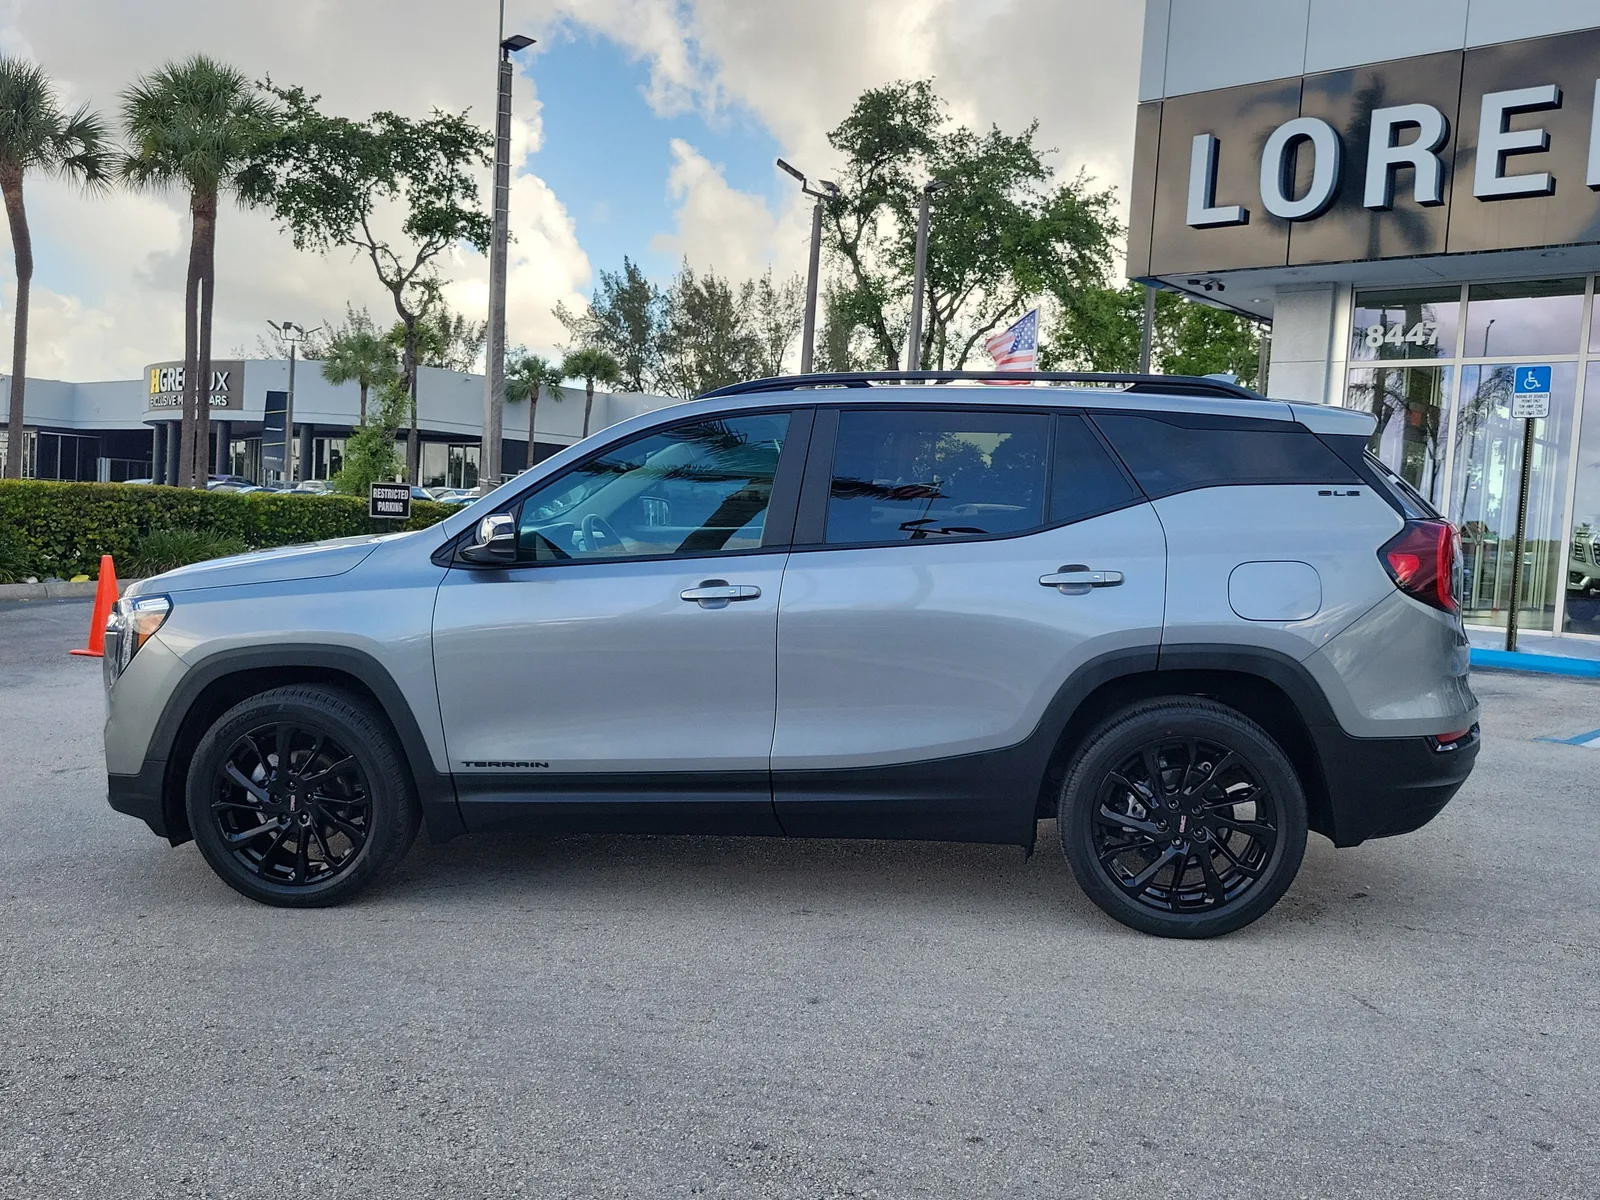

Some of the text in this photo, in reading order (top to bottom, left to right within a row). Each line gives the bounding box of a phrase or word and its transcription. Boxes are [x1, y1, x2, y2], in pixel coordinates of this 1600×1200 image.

[1186, 79, 1600, 229] LORE
[1366, 322, 1444, 347] 8447
[150, 395, 176, 406] EXCLUSIVE
[373, 488, 409, 499] RESTRICTED
[377, 501, 403, 512] PARKING
